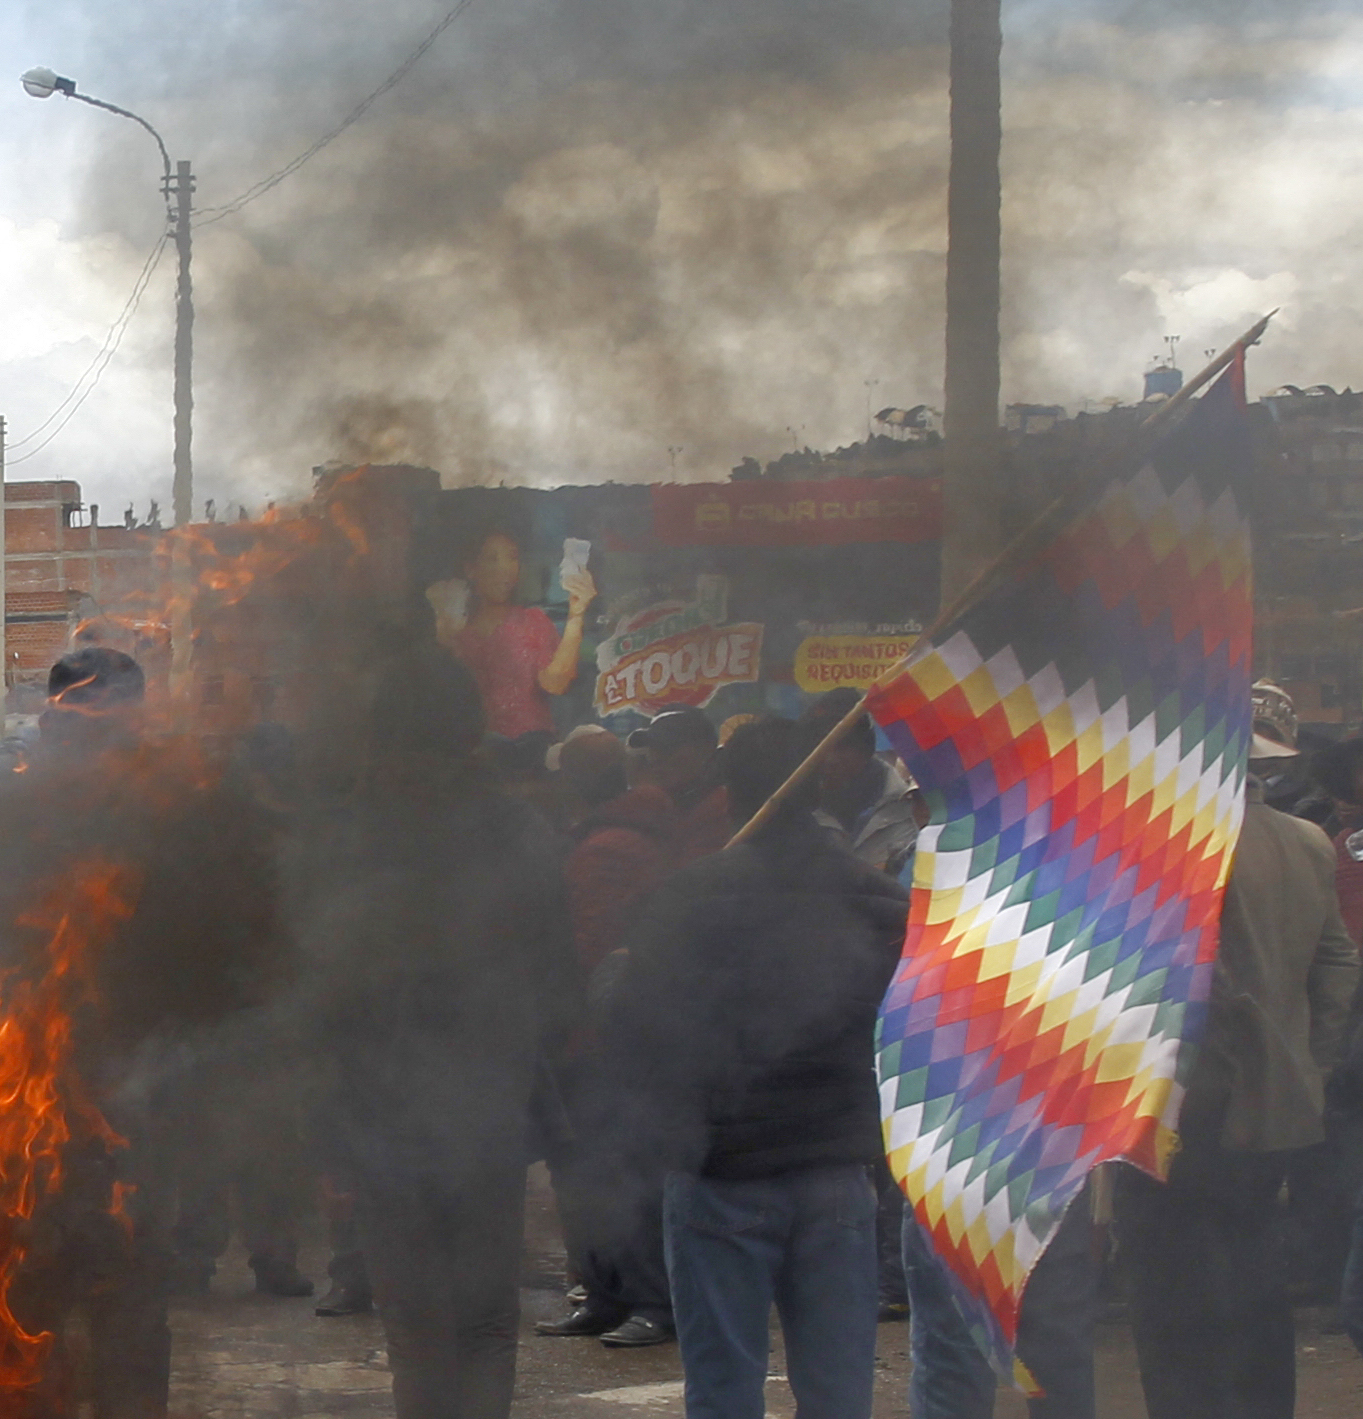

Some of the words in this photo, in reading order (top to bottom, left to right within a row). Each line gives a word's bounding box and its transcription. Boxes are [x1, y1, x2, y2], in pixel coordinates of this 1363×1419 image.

[807, 643, 839, 659] SIN
[844, 642, 910, 659] TANTOS
[616, 634, 755, 699] TOQUE
[807, 663, 893, 683] REQUISIT
